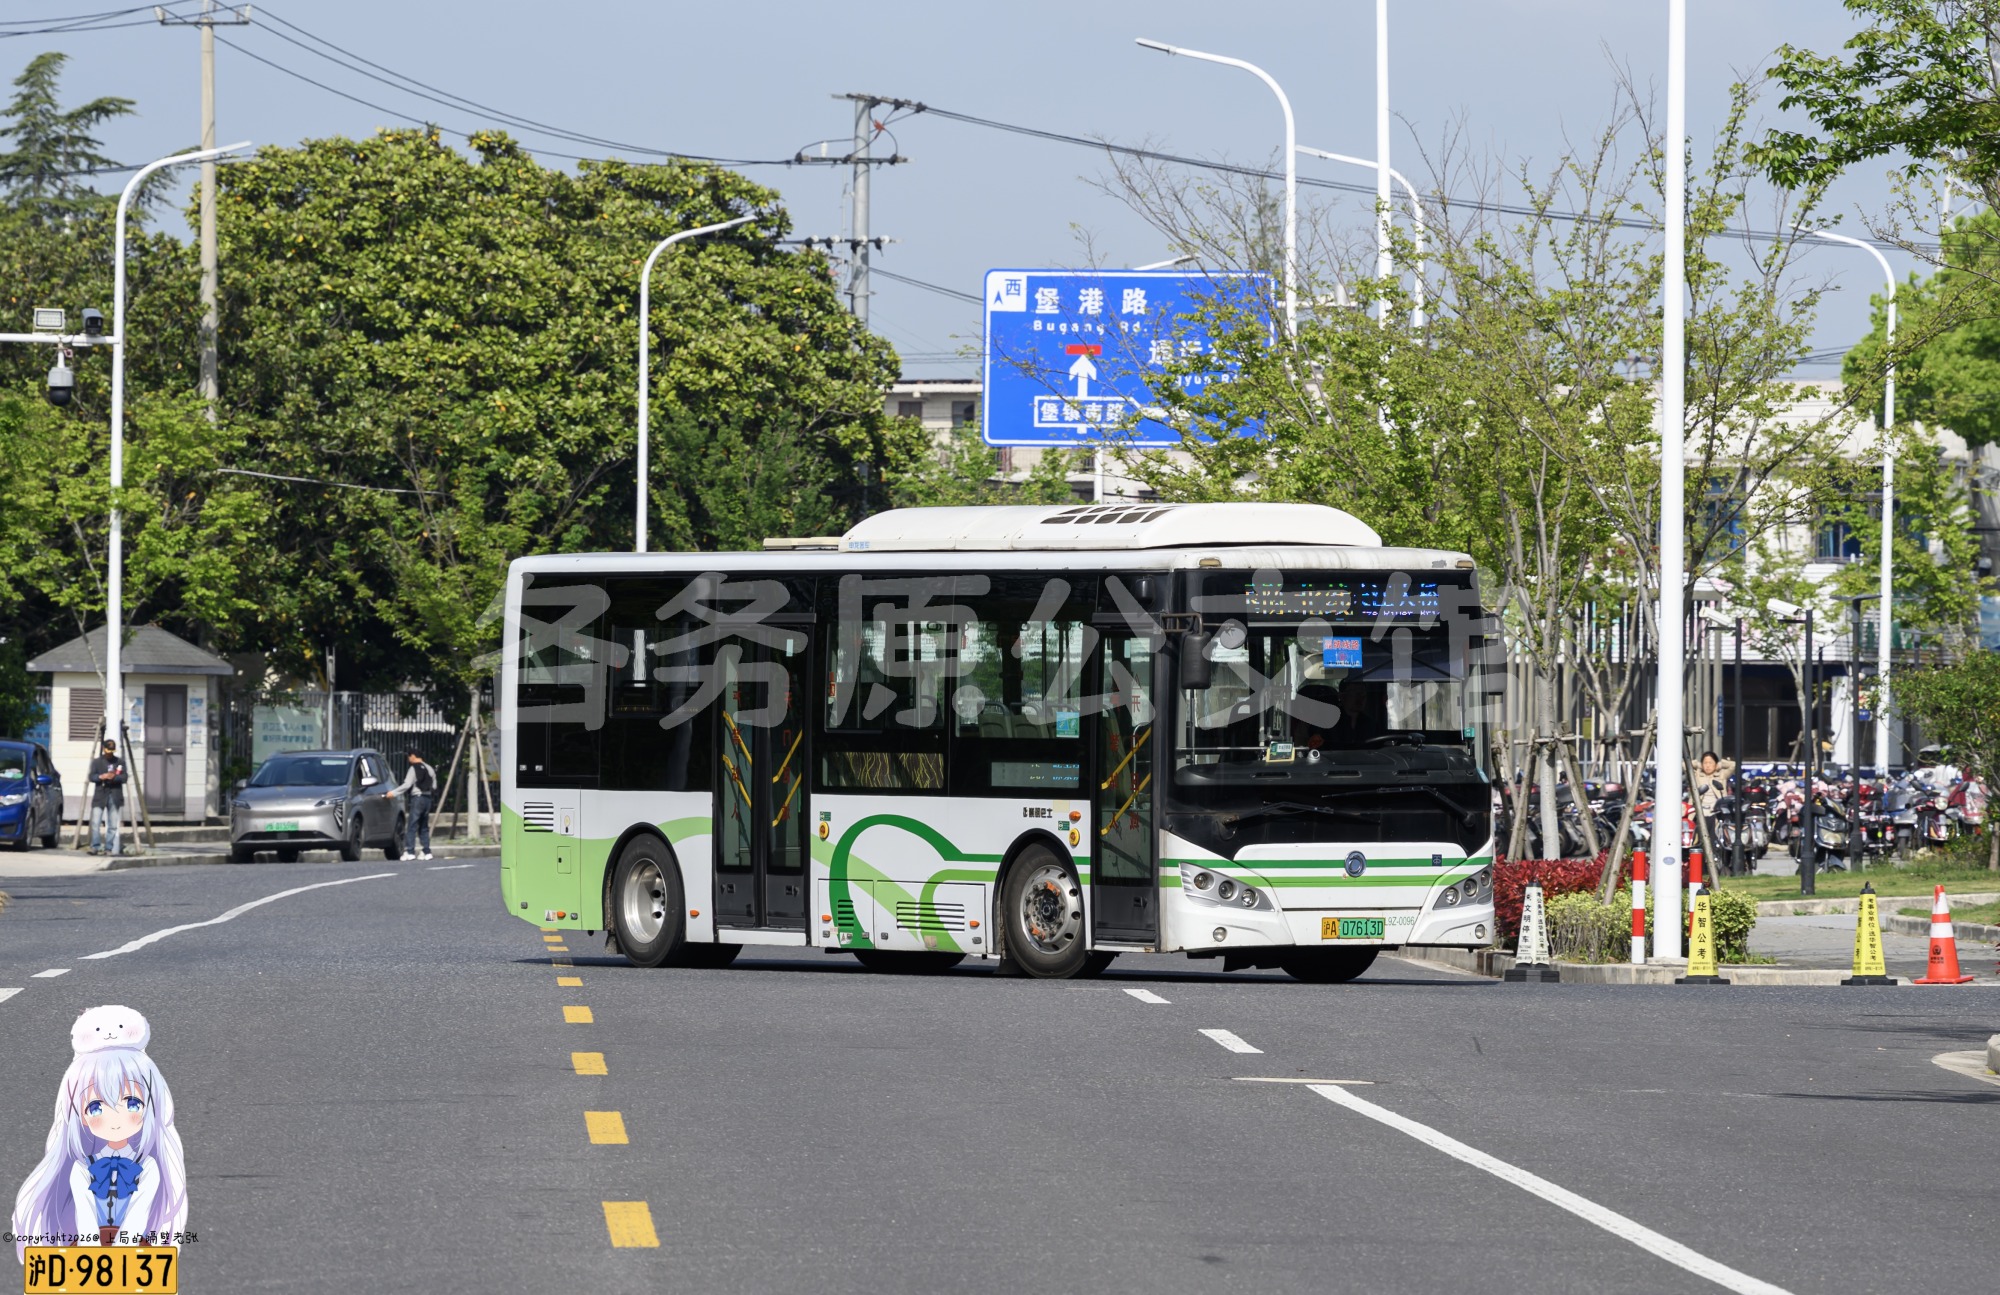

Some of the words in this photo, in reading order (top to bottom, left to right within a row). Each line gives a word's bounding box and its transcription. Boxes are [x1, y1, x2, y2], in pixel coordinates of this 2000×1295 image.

[1005, 279, 1022, 296] 西
[1034, 287, 1147, 315] 堡港路
[1033, 320, 1104, 335] Bugang
[1697, 902, 1706, 959] 华智公考
